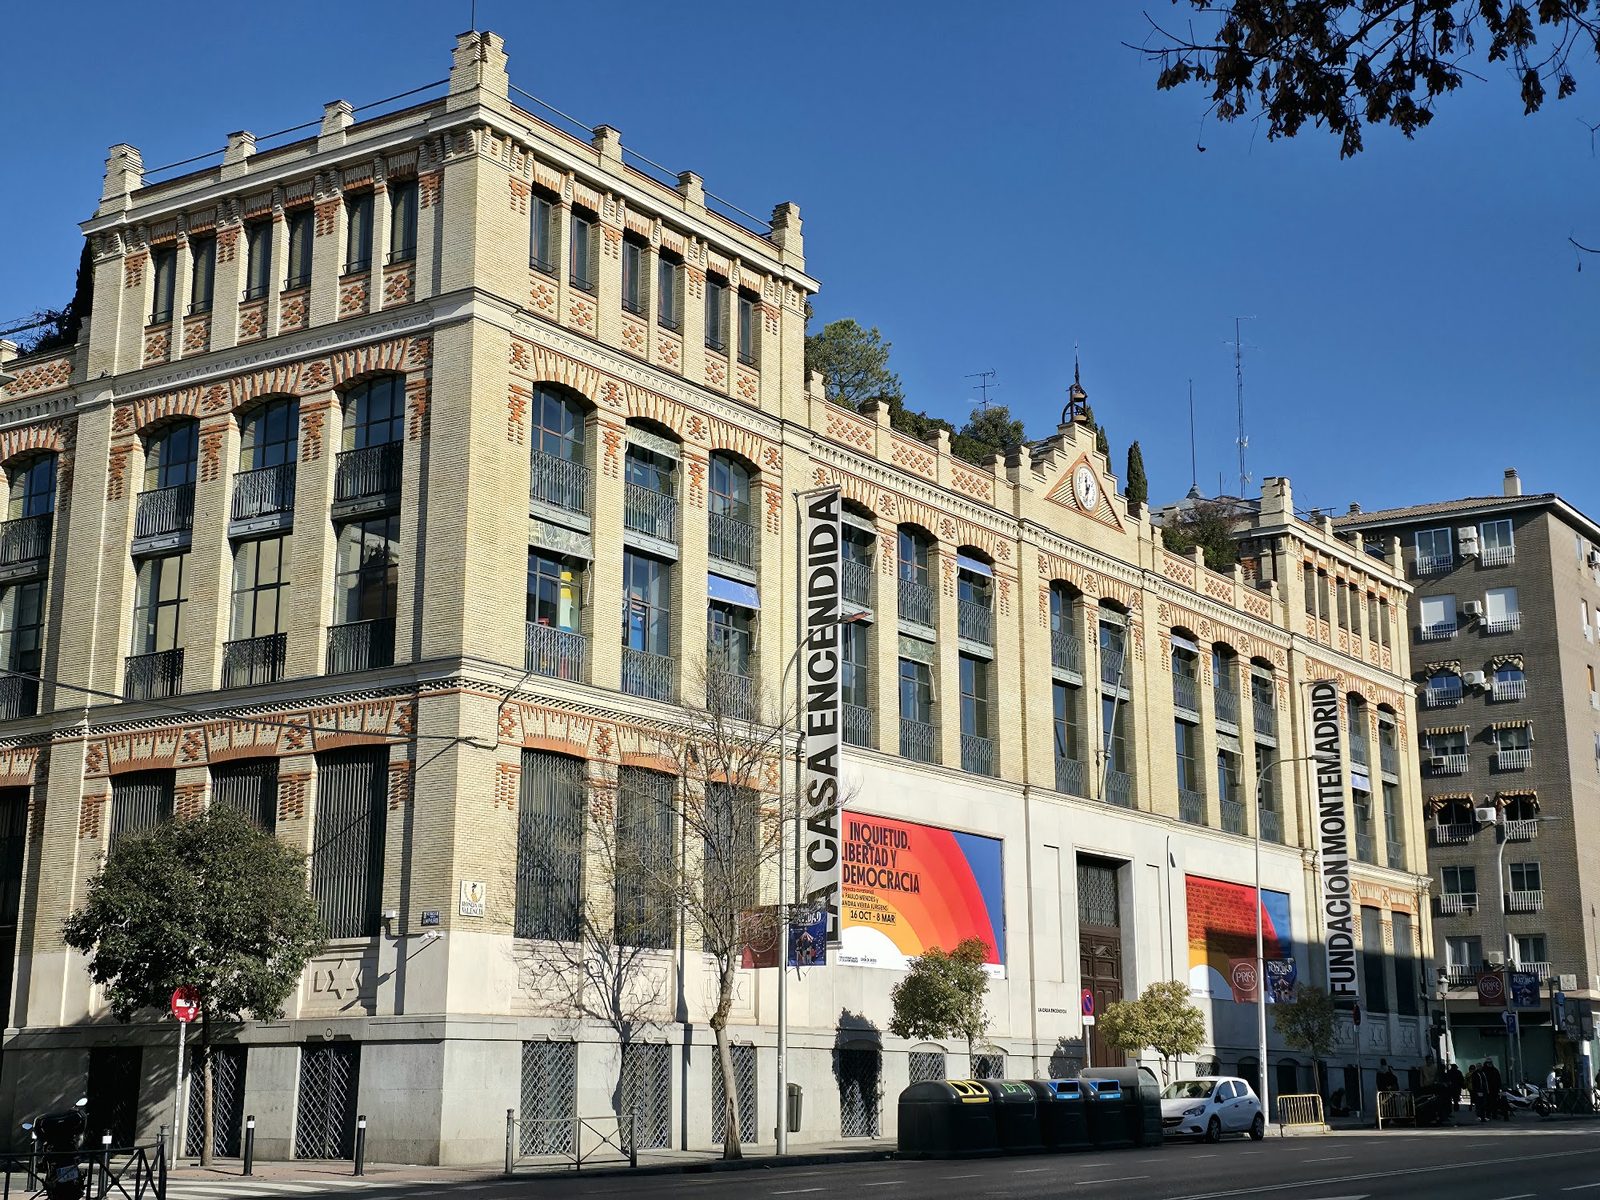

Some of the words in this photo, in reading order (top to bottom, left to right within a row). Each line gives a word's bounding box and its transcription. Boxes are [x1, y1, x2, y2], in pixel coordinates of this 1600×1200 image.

[808, 491, 839, 737] ENCENDIDA
[807, 745, 839, 872] CASA
[1311, 683, 1348, 856] MONTEMADRID
[842, 842, 888, 867] IBERTAD
[890, 849, 897, 868] Y
[850, 821, 911, 850] INQUIETUD.
[843, 863, 920, 893] DEMOCRACIA
[850, 910, 858, 919] 16
[859, 910, 872, 921] OCT
[877, 912, 881, 922] 8
[882, 913, 896, 923] MAR
[1324, 859, 1357, 997] FUNDACIÓN
